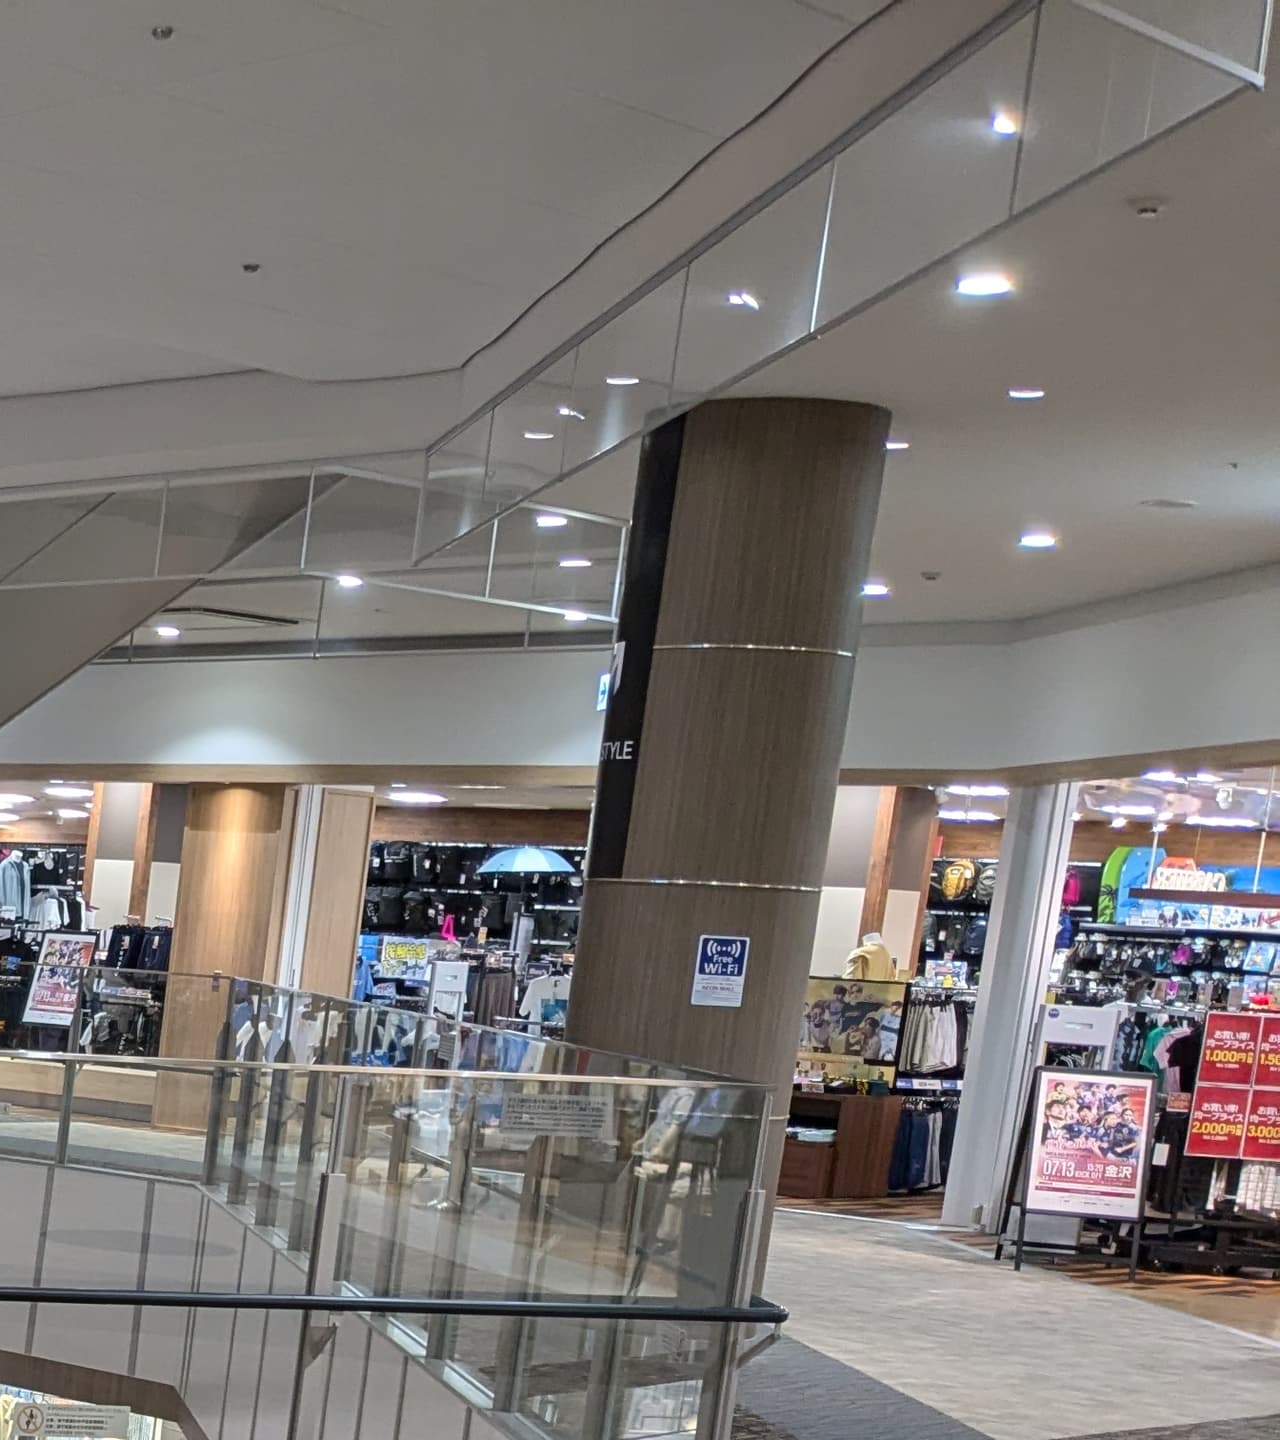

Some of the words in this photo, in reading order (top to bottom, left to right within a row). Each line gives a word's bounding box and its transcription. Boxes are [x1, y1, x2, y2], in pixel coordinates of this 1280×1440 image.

[713, 954, 734, 964] Free
[704, 962, 739, 975] Wi-Fi
[1043, 1160, 1075, 1177] 07.13
[1104, 1164, 1133, 1178] 金沢
